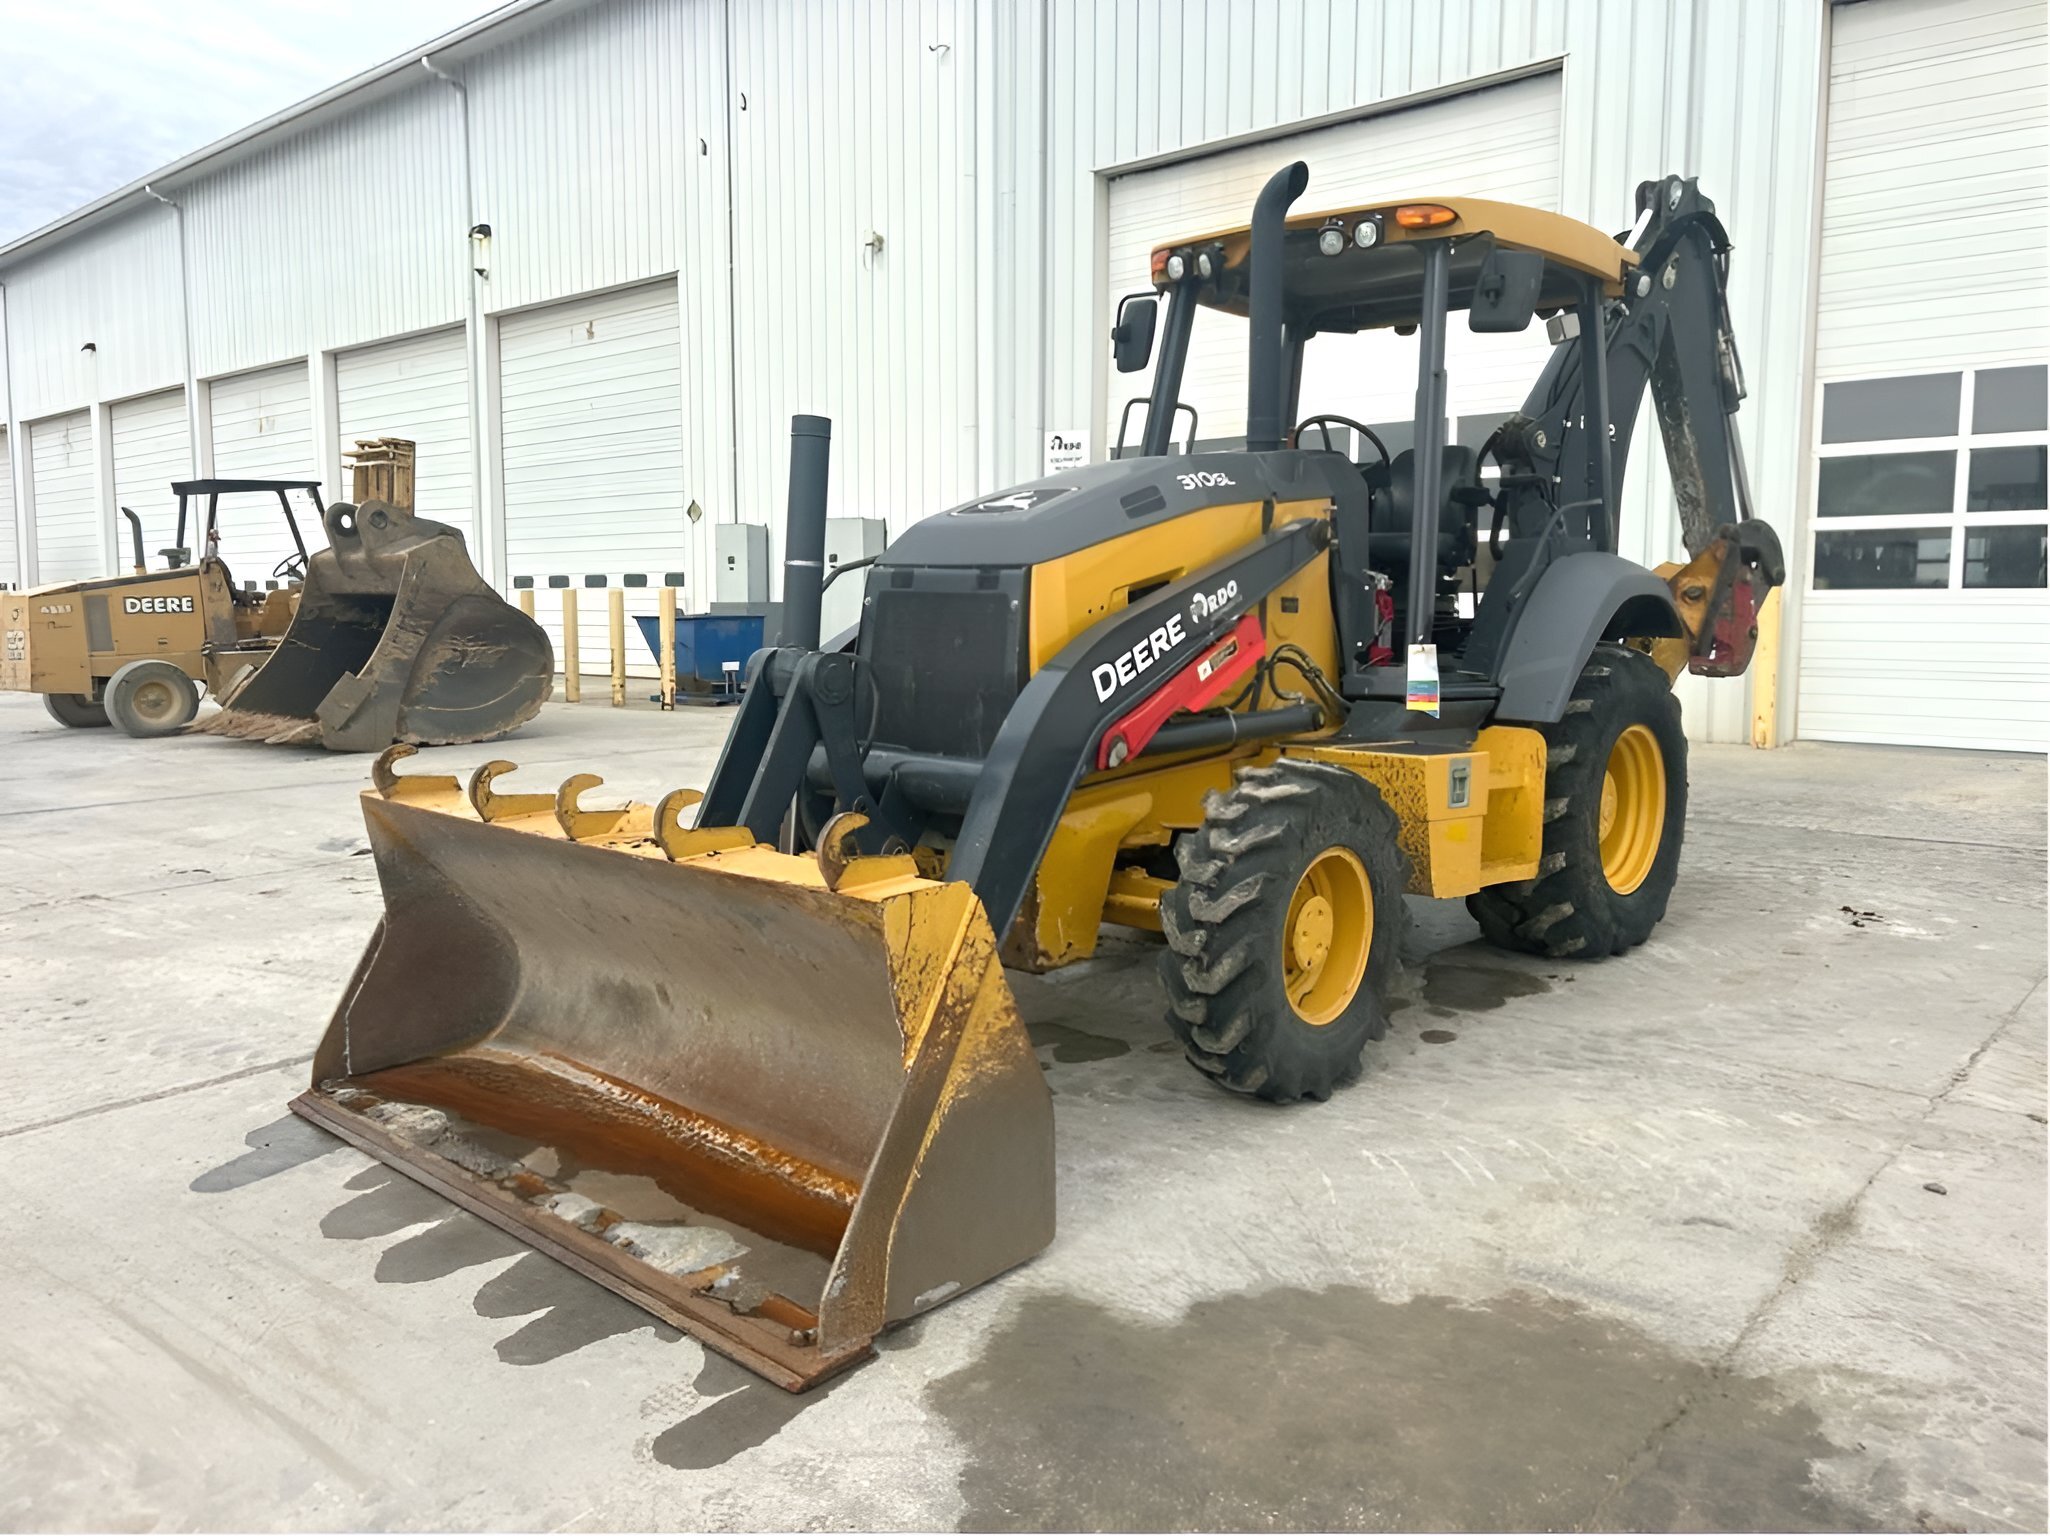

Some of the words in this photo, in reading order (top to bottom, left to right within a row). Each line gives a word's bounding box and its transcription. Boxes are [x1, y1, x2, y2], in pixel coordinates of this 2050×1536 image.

[125, 597, 193, 613] DEERE
[1207, 580, 1238, 613] RDO
[1091, 613, 1186, 703] DEERE
